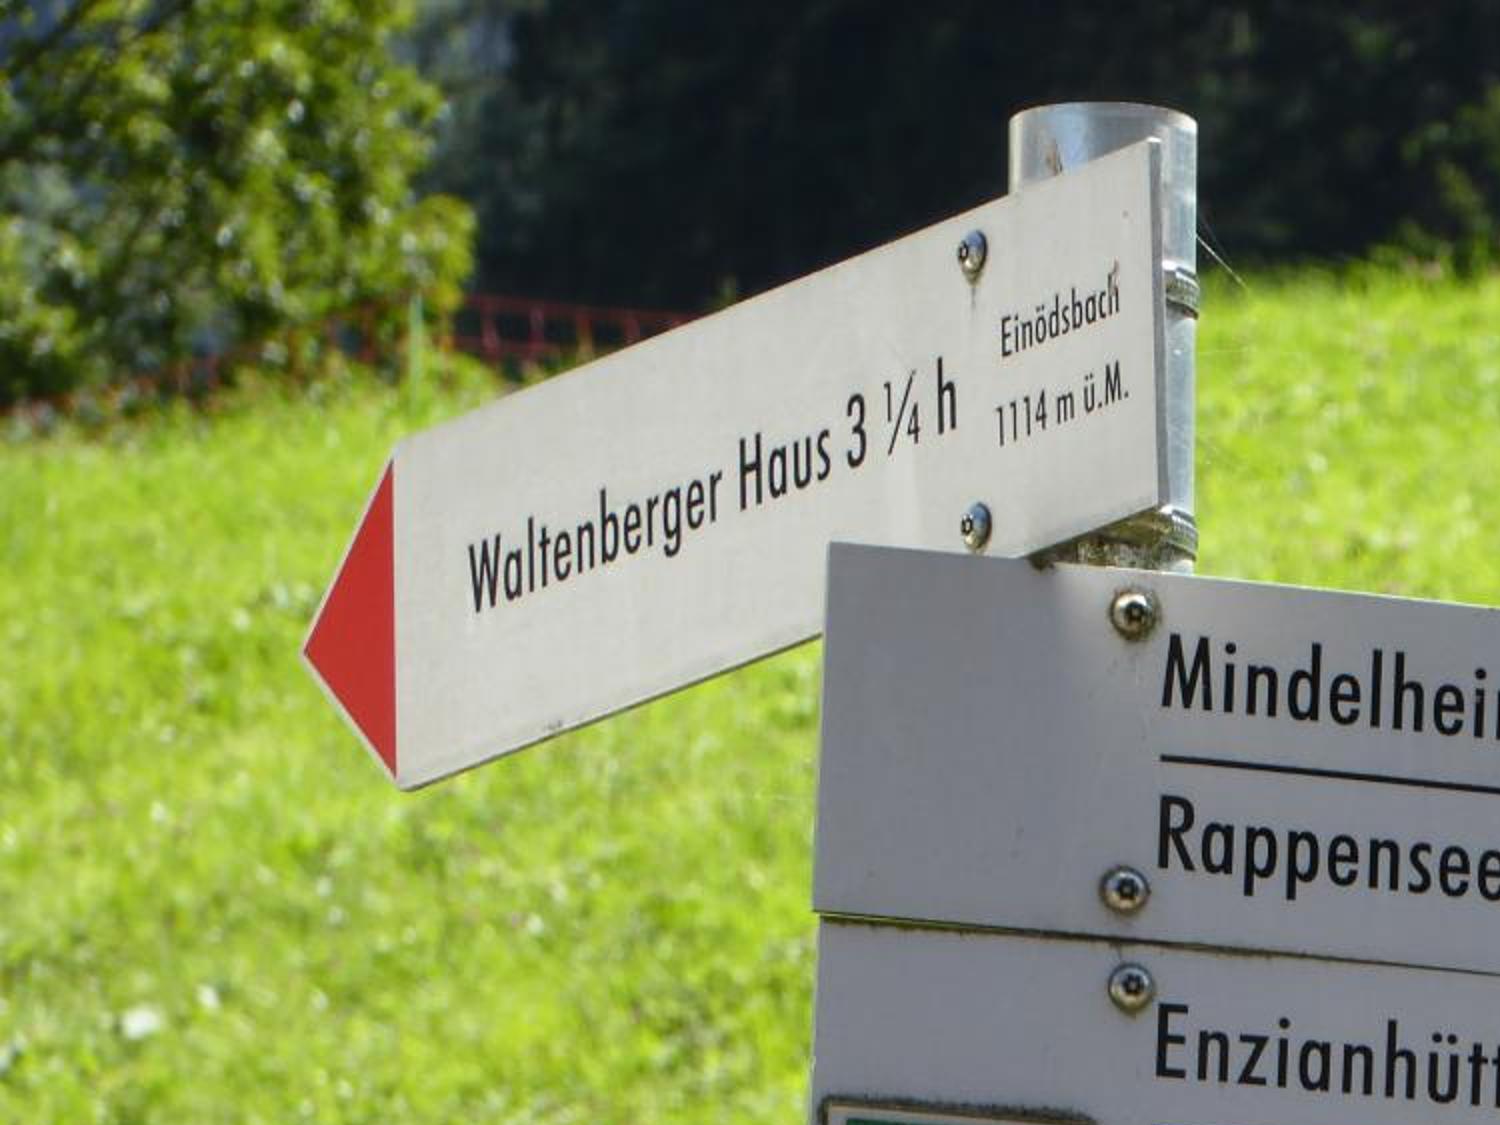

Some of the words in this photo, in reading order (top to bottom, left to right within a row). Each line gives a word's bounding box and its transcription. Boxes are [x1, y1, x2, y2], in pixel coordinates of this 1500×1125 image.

[1000, 270, 1121, 359] Einödsbach
[994, 387, 1049, 448] 1114
[1055, 390, 1076, 426] m
[466, 468, 724, 615] Waltenberger
[737, 427, 833, 514] Haus
[844, 391, 869, 471] 3
[935, 354, 958, 435] h
